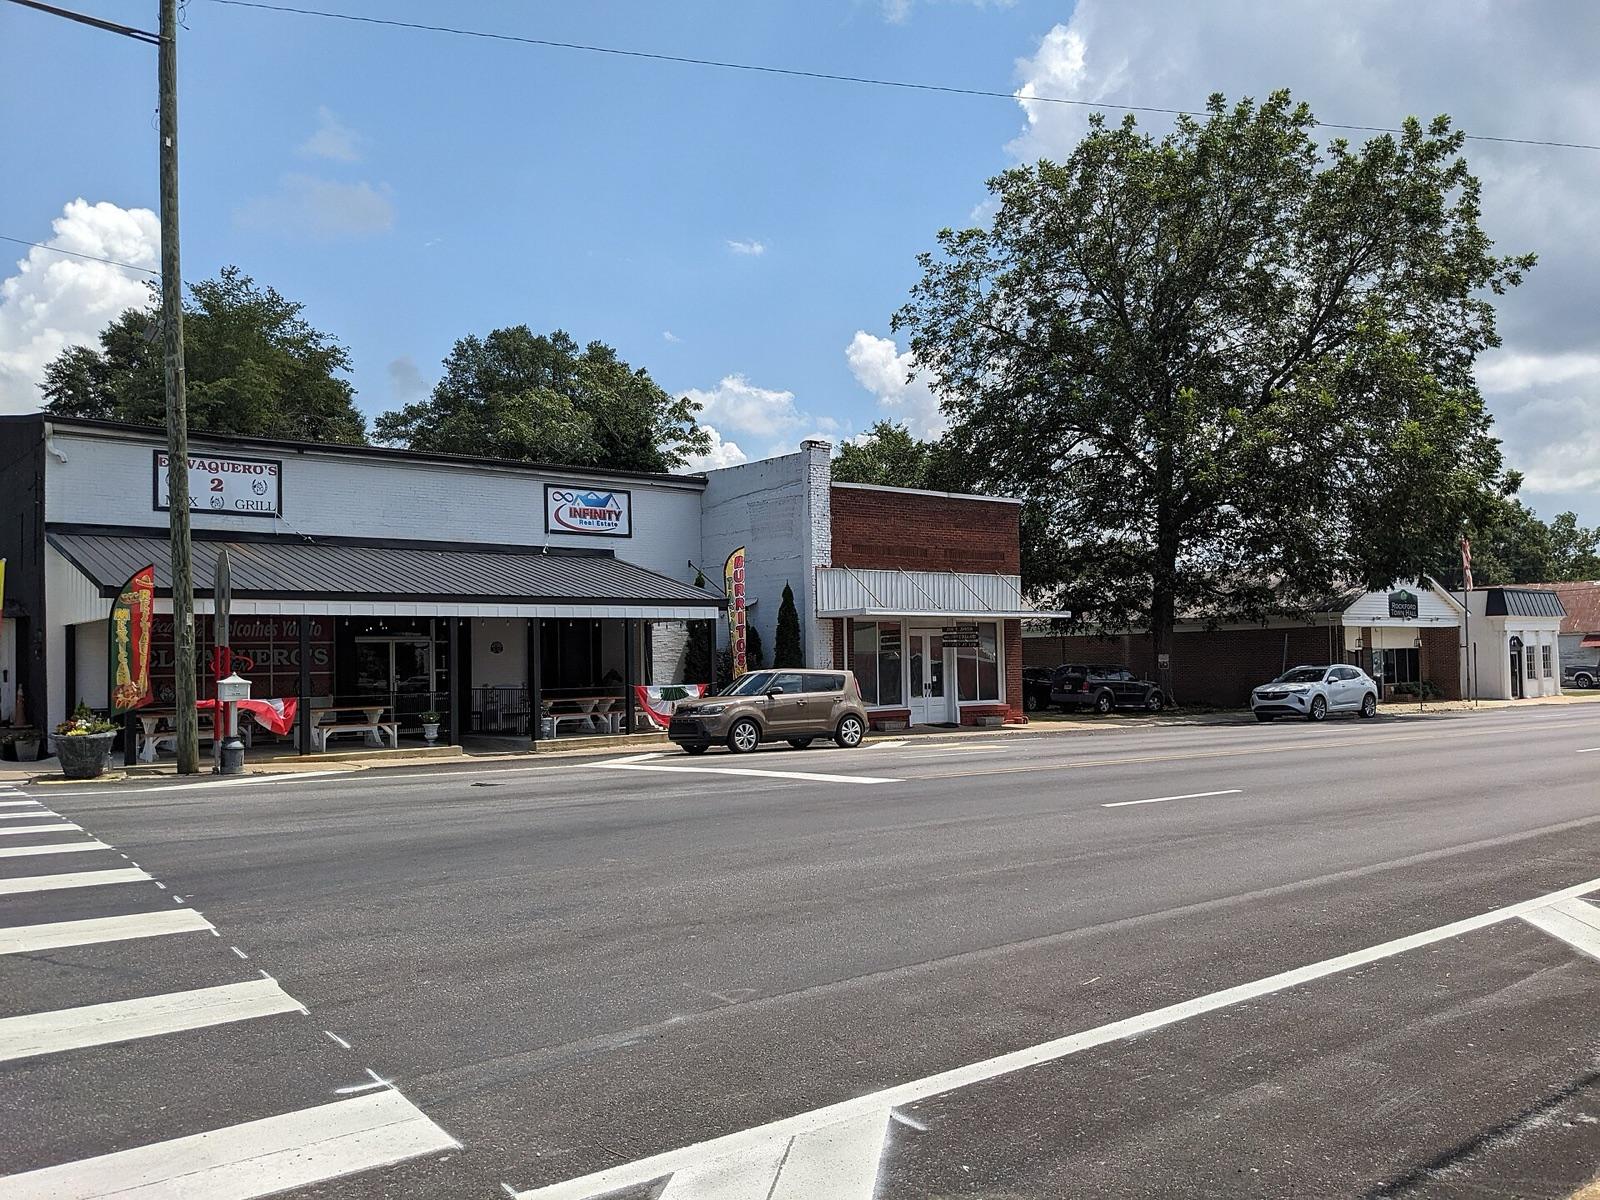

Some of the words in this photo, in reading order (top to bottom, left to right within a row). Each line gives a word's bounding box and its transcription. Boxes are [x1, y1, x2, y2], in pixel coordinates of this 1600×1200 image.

[210, 478, 224, 493] 2
[234, 499, 277, 511] GRILL
[568, 507, 623, 521] INFINITY
[578, 519, 595, 527] Real
[733, 555, 745, 668] BURRITOS
[1391, 602, 1417, 610] ROCKFORD
[1405, 609, 1417, 617] HALL
[113, 608, 131, 685] MEXICAN
